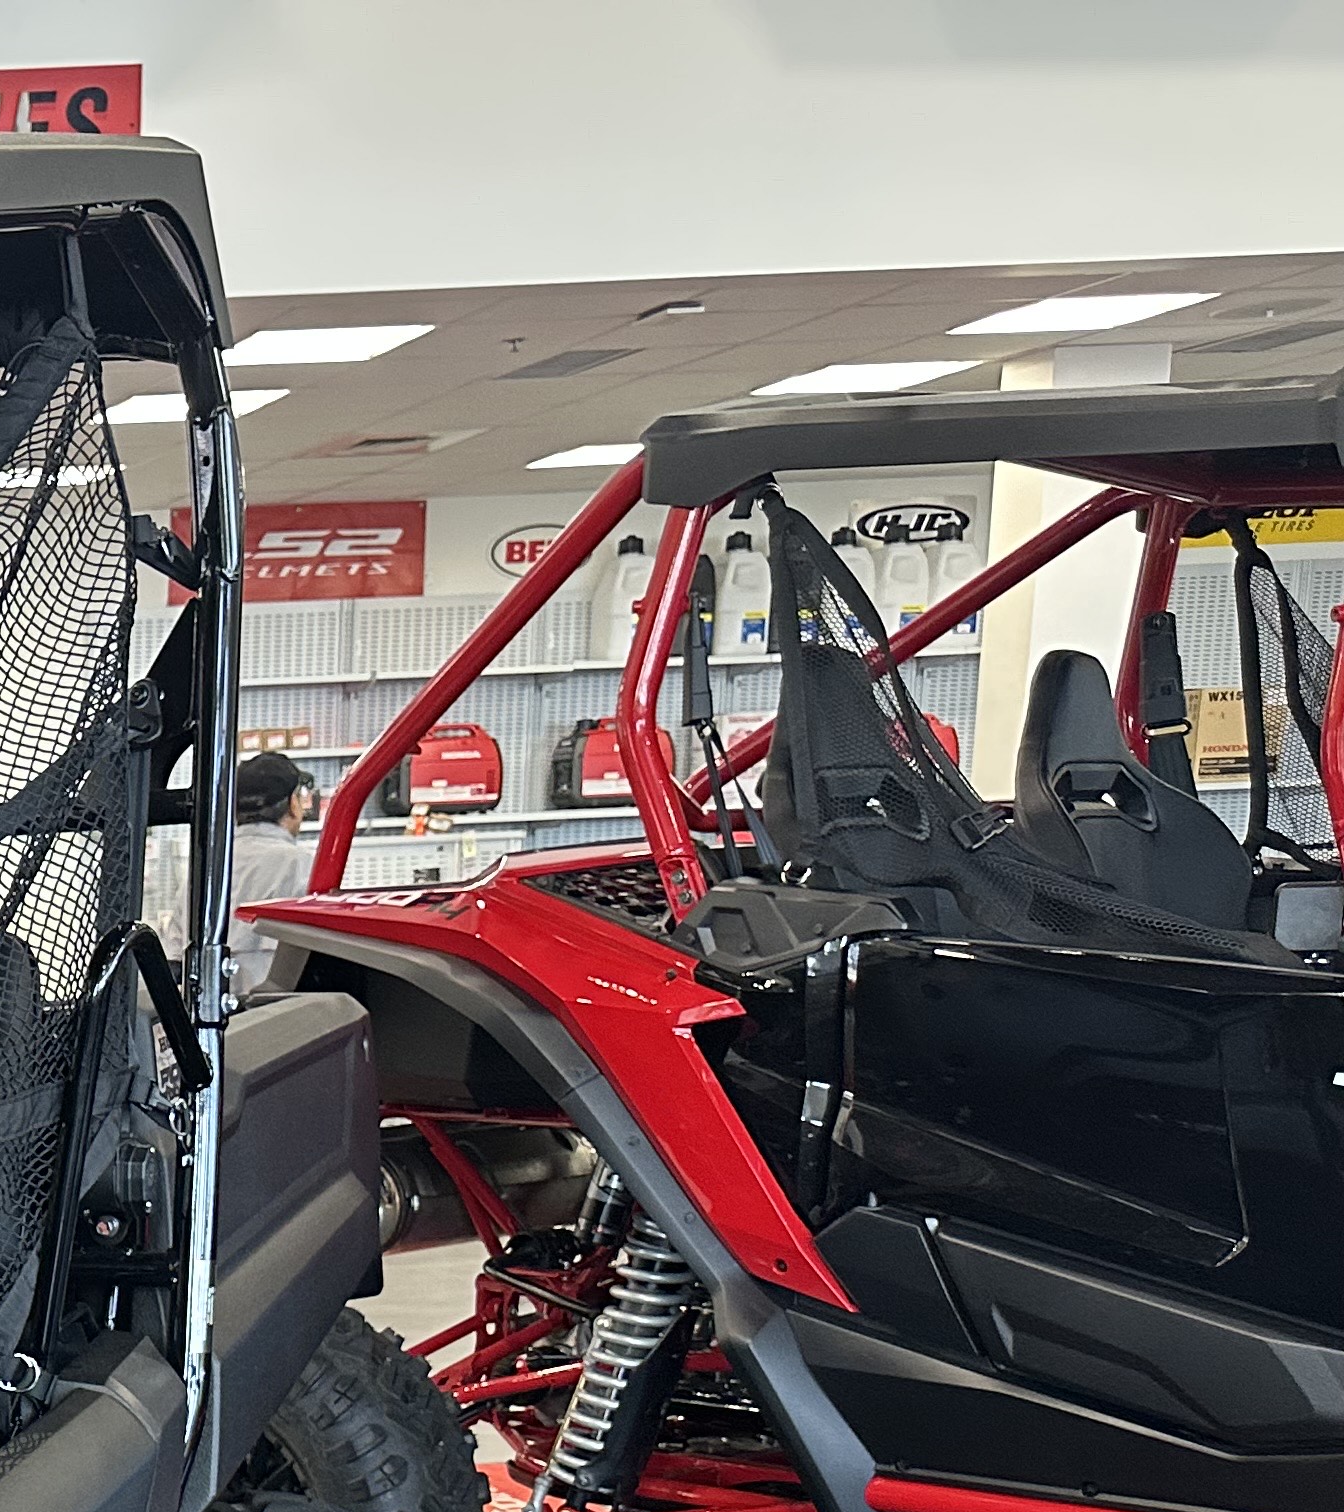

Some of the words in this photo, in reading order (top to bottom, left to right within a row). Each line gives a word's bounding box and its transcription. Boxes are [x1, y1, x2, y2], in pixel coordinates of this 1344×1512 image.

[1271, 519, 1315, 532] TIRES
[245, 528, 403, 560] S2
[243, 560, 391, 578] LMETS
[1202, 744, 1248, 753] HONDA
